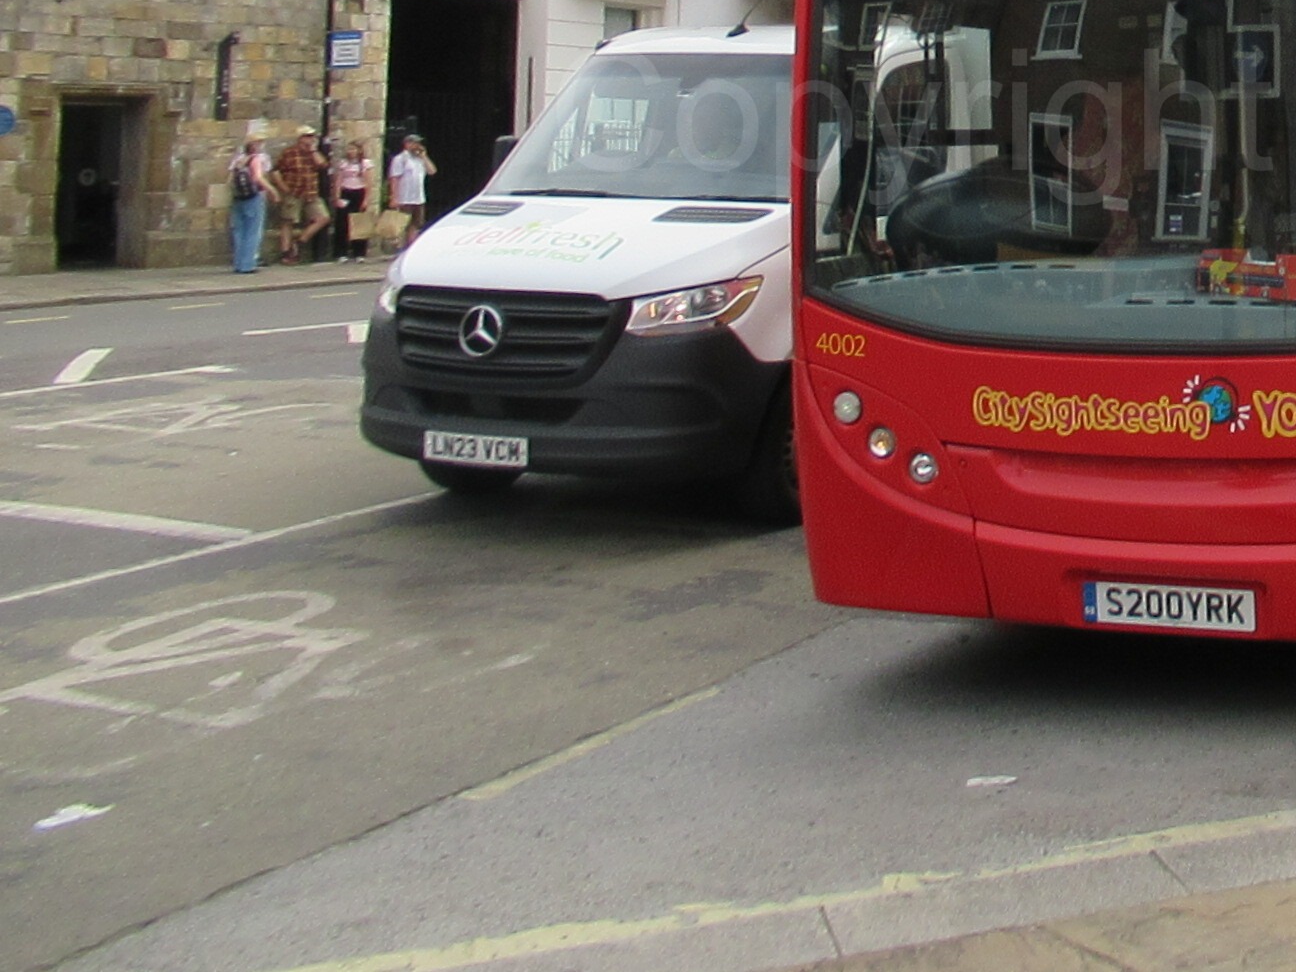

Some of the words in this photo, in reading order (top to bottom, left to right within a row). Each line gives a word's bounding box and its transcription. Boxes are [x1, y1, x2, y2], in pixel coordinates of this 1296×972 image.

[815, 332, 867, 358] 4002
[972, 385, 1212, 440] CitySightseeing
[430, 432, 478, 459] LN23
[482, 436, 522, 463] VCM
[1105, 586, 1245, 625] S200YRK
